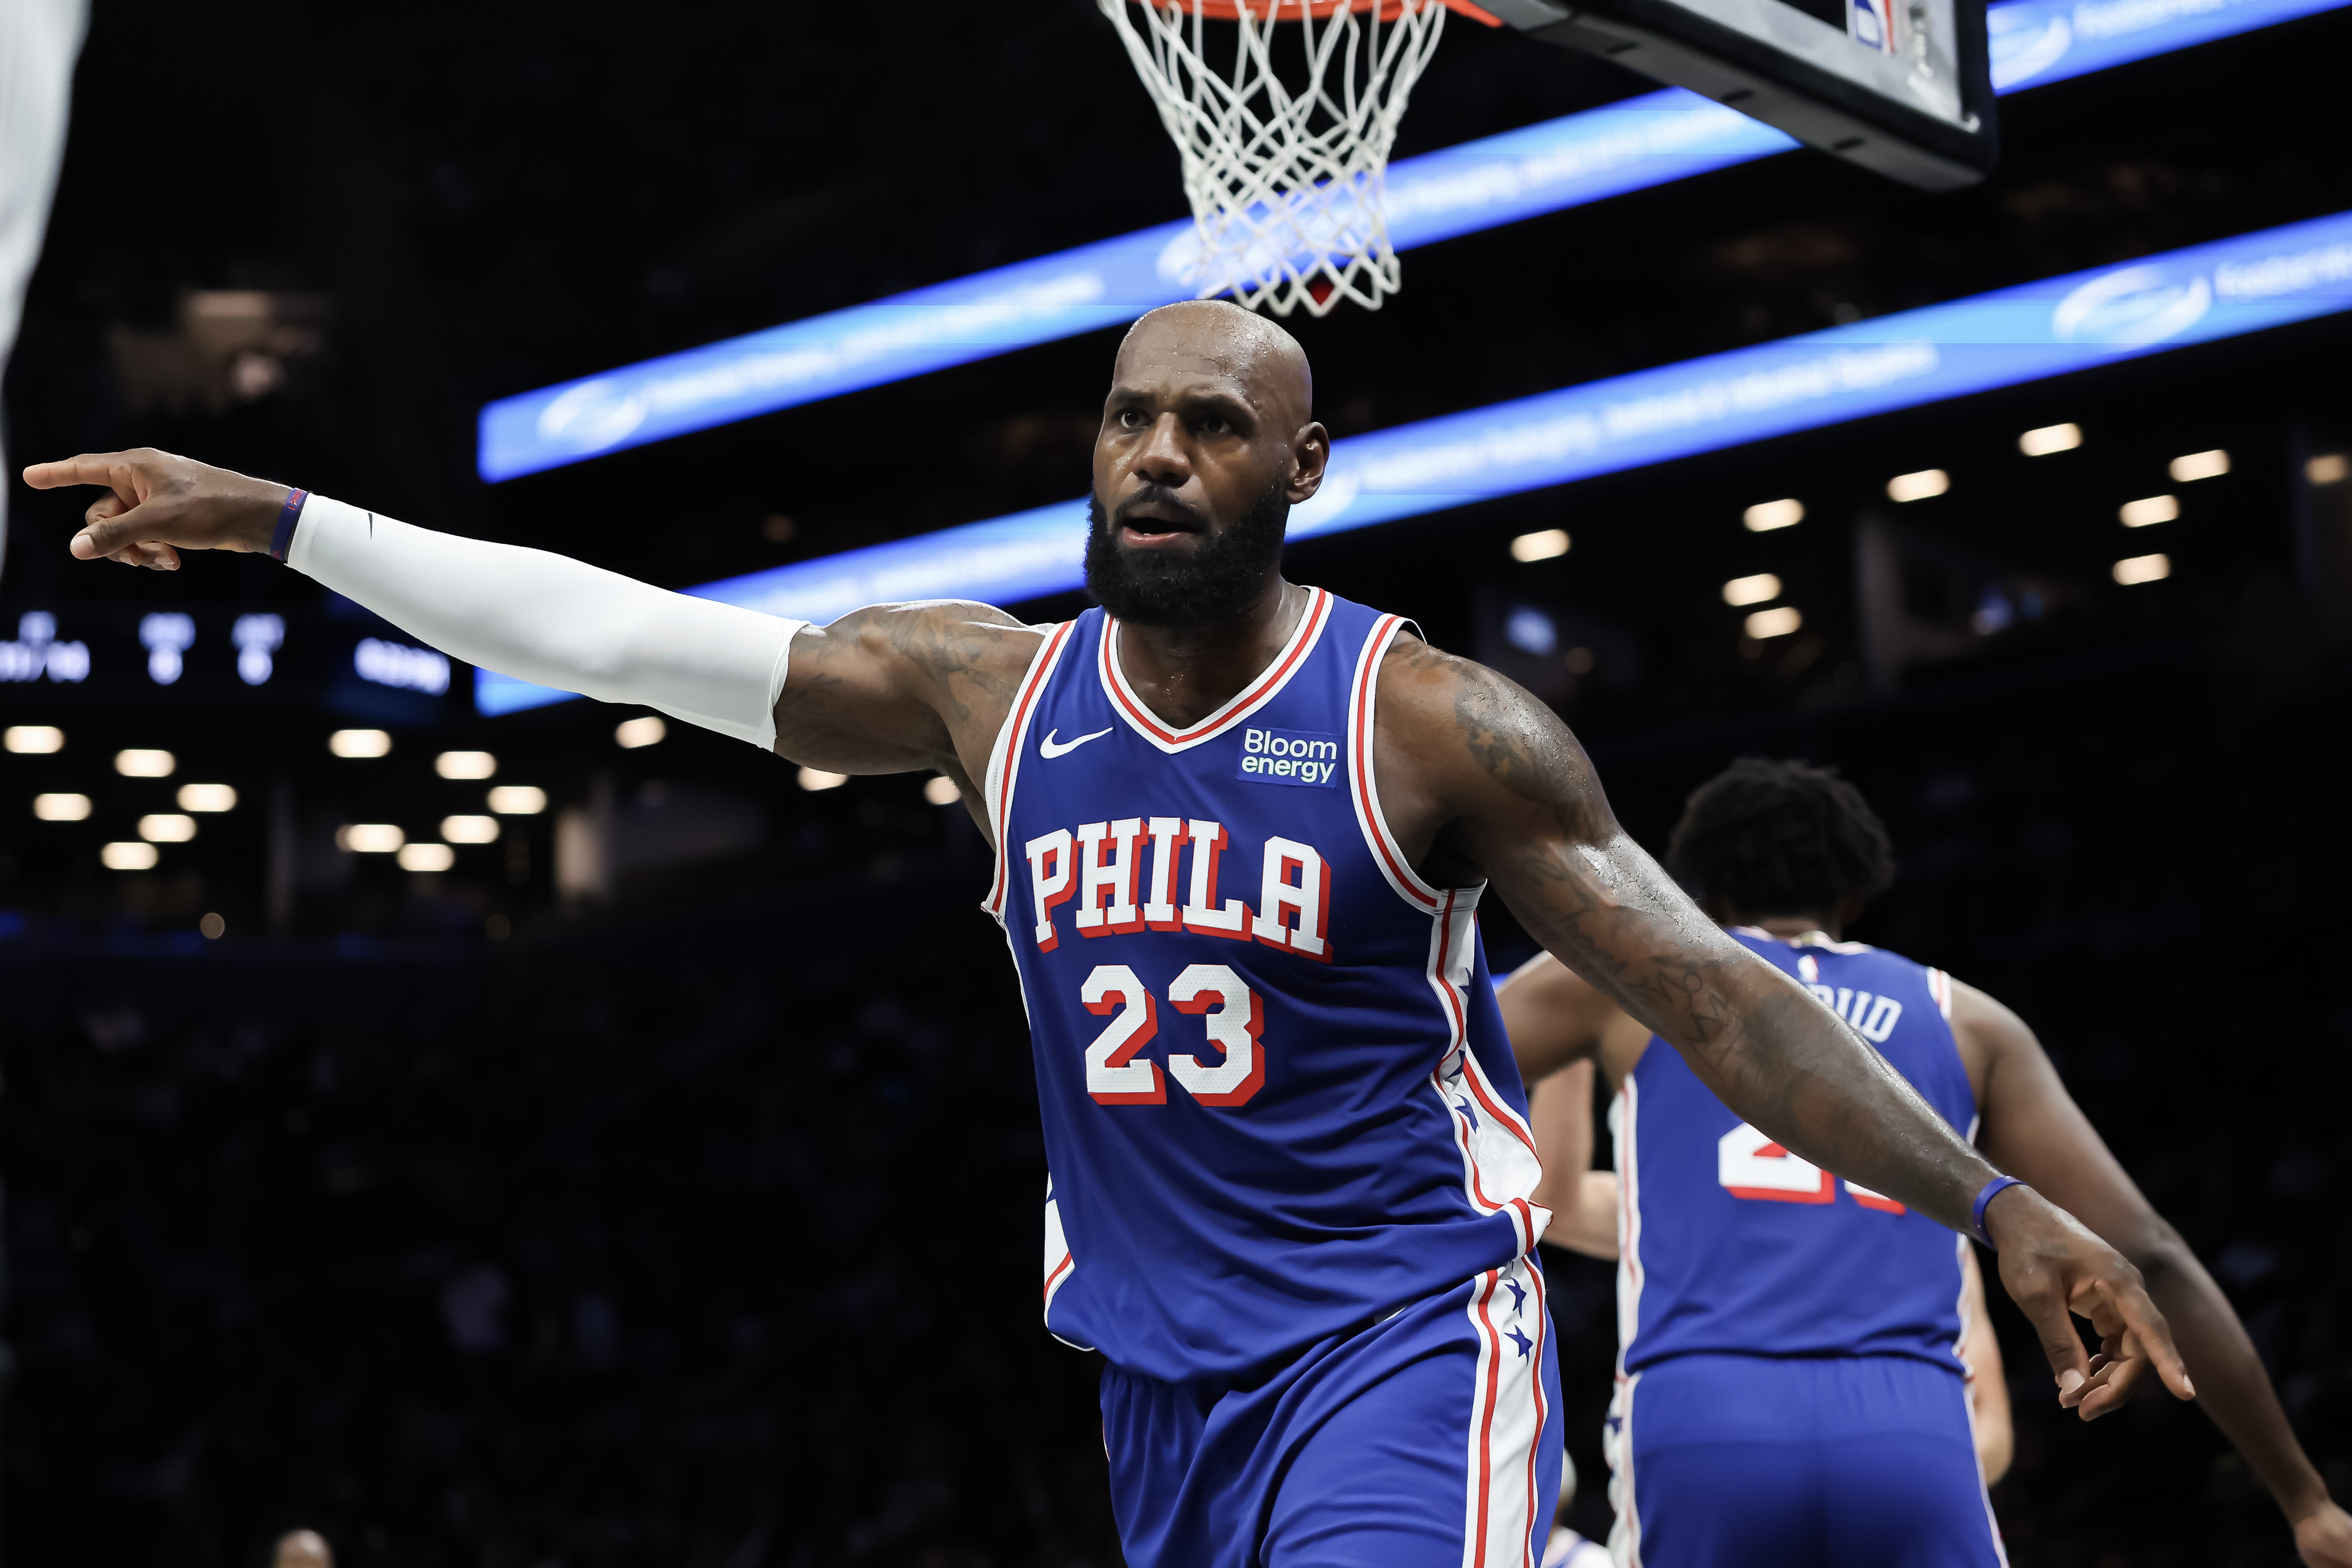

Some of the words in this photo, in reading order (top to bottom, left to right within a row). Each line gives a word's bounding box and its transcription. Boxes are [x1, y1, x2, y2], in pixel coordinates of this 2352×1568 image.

[1241, 756, 1336, 784] energy
[1244, 728, 1337, 760] Bloom
[1025, 817, 1333, 964] PHILA
[1081, 964, 1265, 1107] 23
